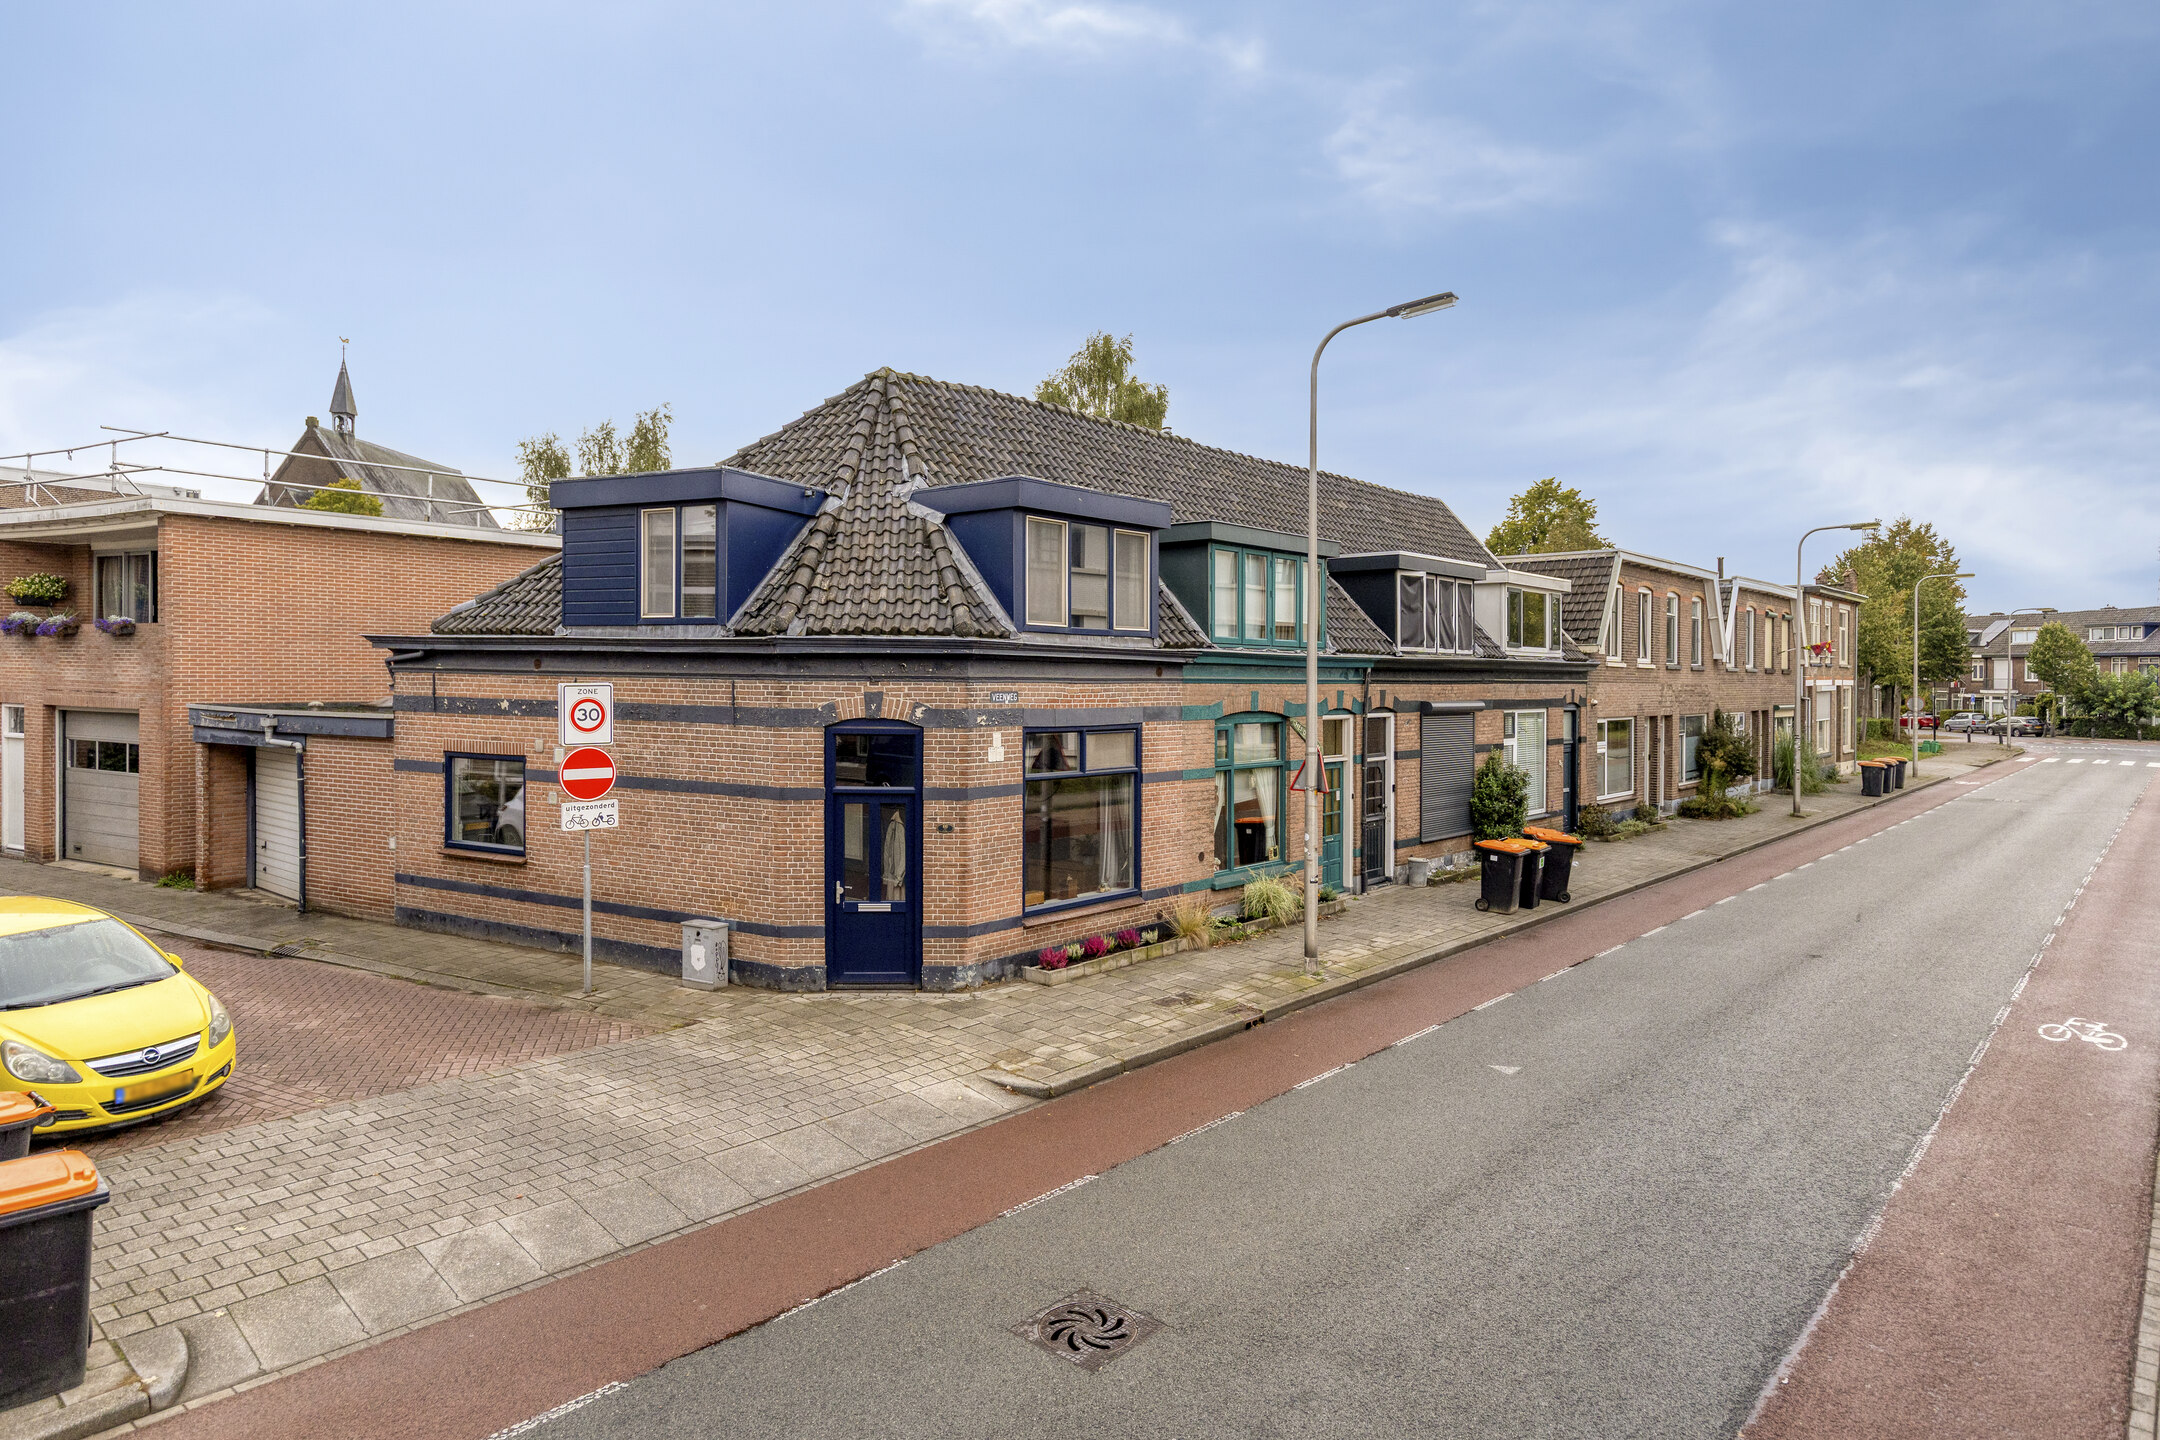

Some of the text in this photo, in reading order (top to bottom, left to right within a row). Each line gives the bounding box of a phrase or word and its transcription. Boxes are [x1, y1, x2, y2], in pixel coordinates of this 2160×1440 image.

[991, 693, 1018, 702] VEENWEG
[577, 708, 600, 722] 30
[565, 802, 615, 813] uitgezonderd
